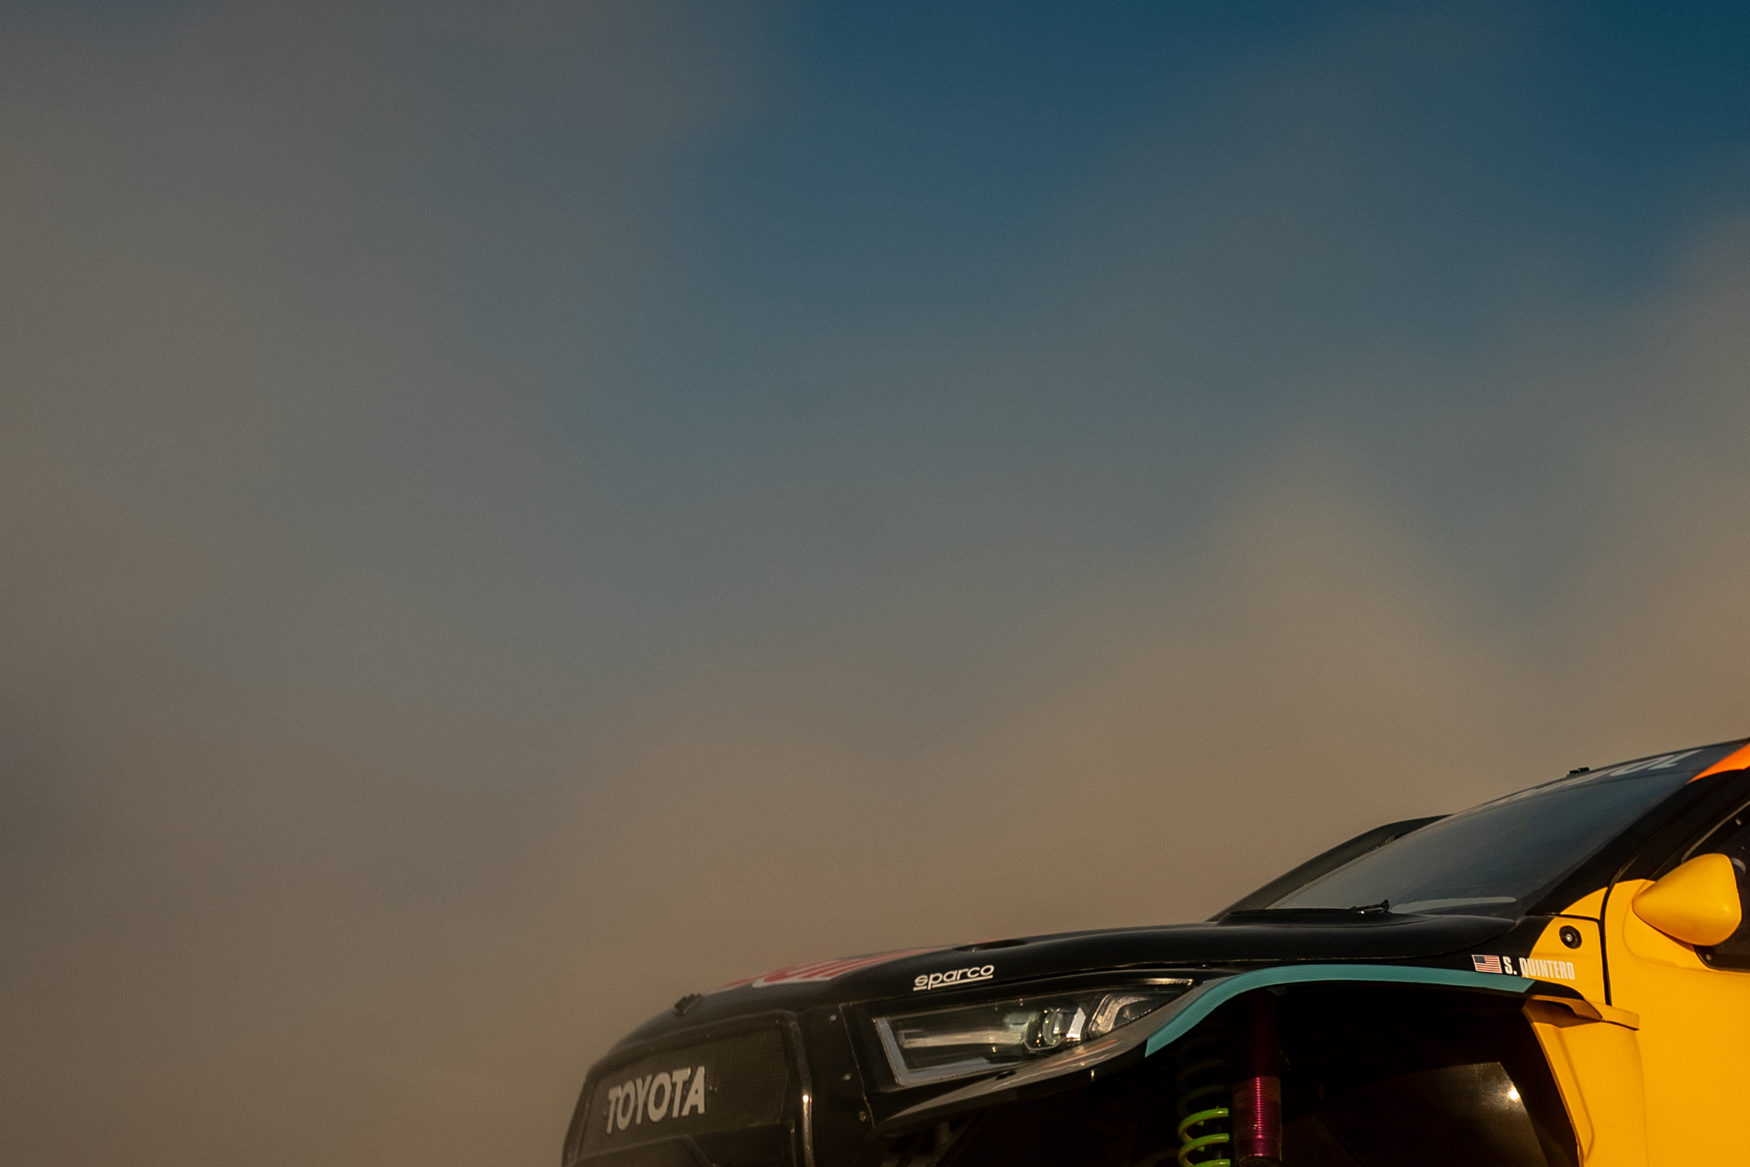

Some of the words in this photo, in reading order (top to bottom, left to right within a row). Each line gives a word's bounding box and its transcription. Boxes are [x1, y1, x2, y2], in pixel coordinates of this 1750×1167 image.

[913, 965, 994, 990] sparco
[1502, 956, 1518, 975] S.
[1519, 957, 1575, 980] QUINTERO
[606, 1065, 705, 1134] TOYOTA
